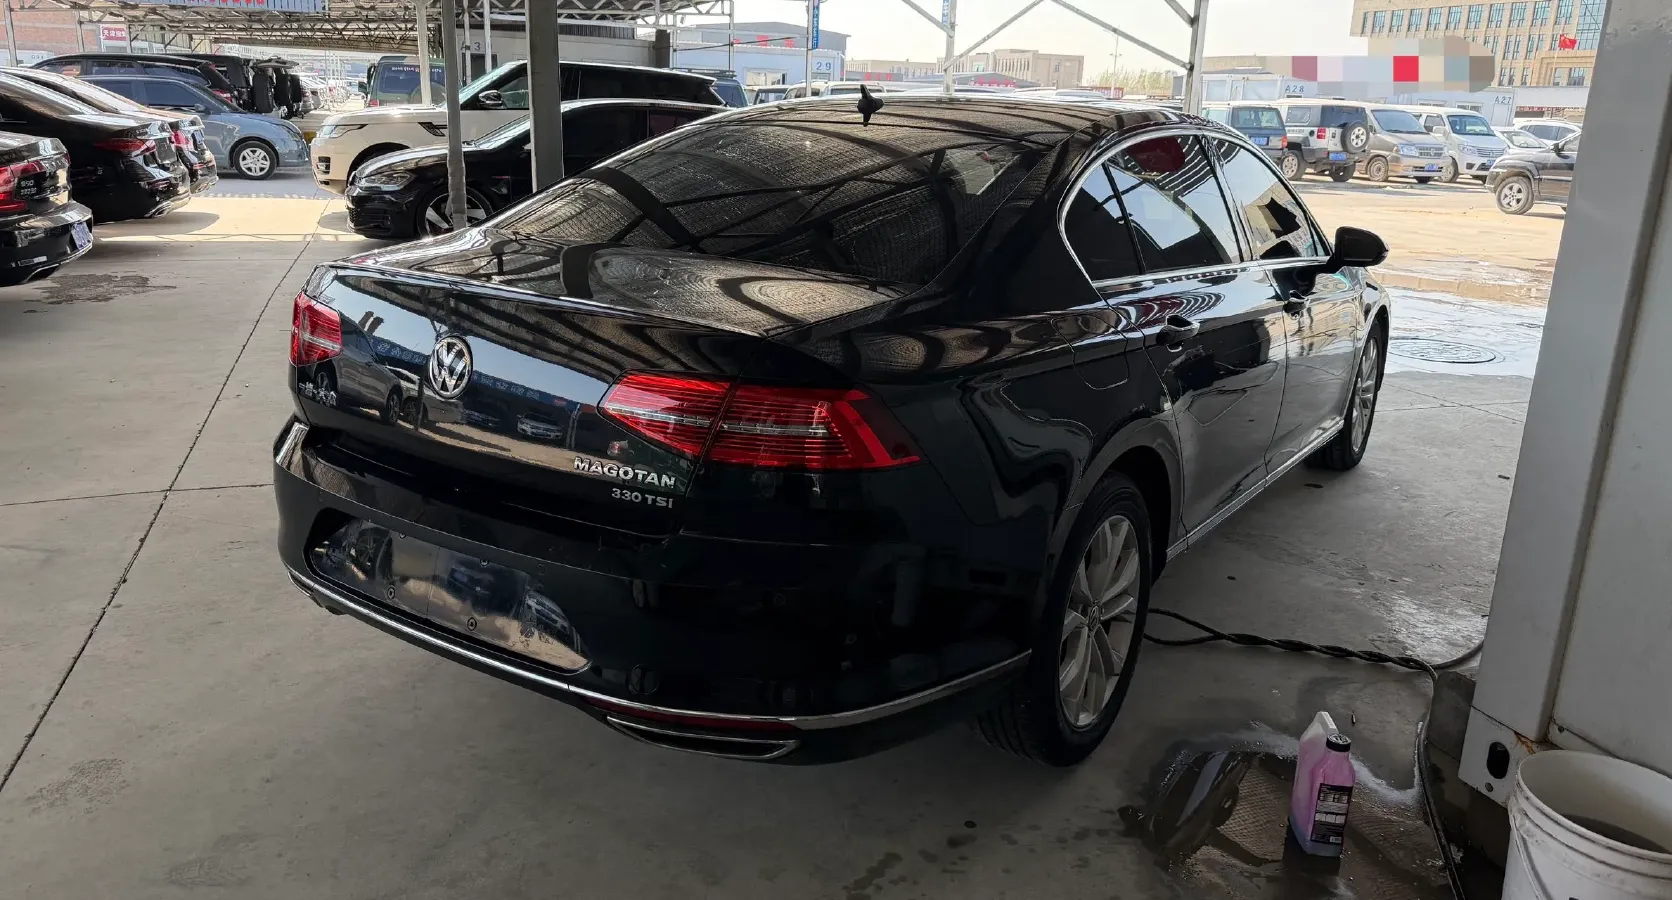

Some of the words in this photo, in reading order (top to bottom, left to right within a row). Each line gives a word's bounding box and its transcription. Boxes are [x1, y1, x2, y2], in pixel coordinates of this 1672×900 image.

[1285, 84, 1305, 93] A28
[1494, 95, 1512, 105] A27
[573, 456, 676, 488] MAGOTAN
[611, 487, 642, 503] 330
[644, 494, 674, 509] TSI
